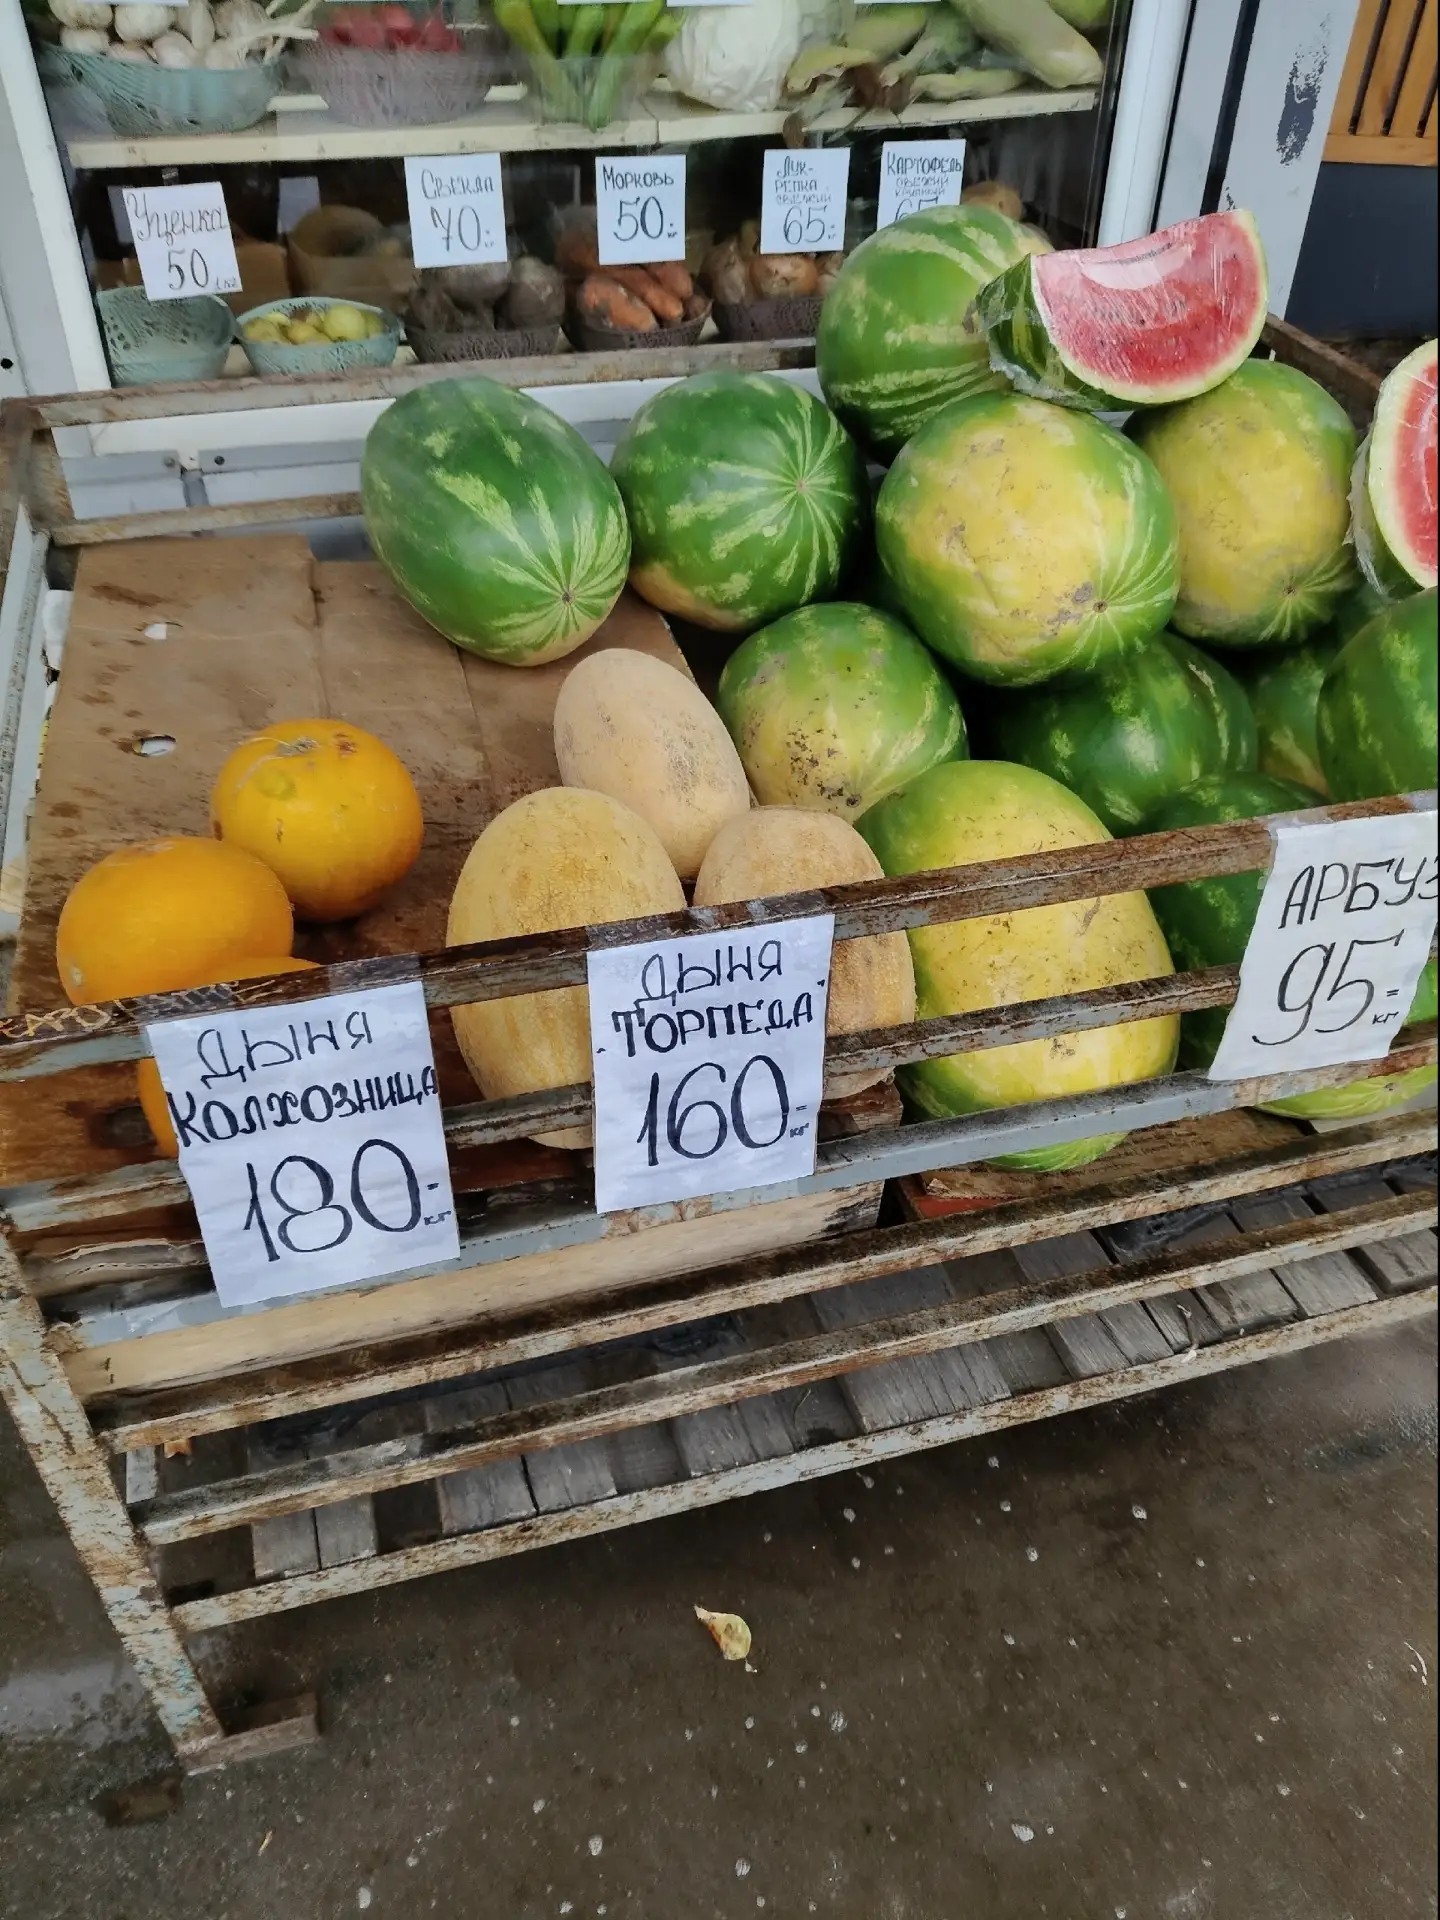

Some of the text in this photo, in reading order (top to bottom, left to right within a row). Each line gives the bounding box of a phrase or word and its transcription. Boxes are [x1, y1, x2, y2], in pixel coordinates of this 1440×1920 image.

[168, 248, 208, 290] 50
[633, 939, 782, 1011] ДЫНЯ
[1372, 1011, 1399, 1025] кг
[197, 1011, 373, 1089] ДЫНЯ
[166, 1065, 438, 1148] КОЛХОЗНИЦА
[789, 1123, 810, 1138] кг
[423, 1211, 451, 1226] кг
